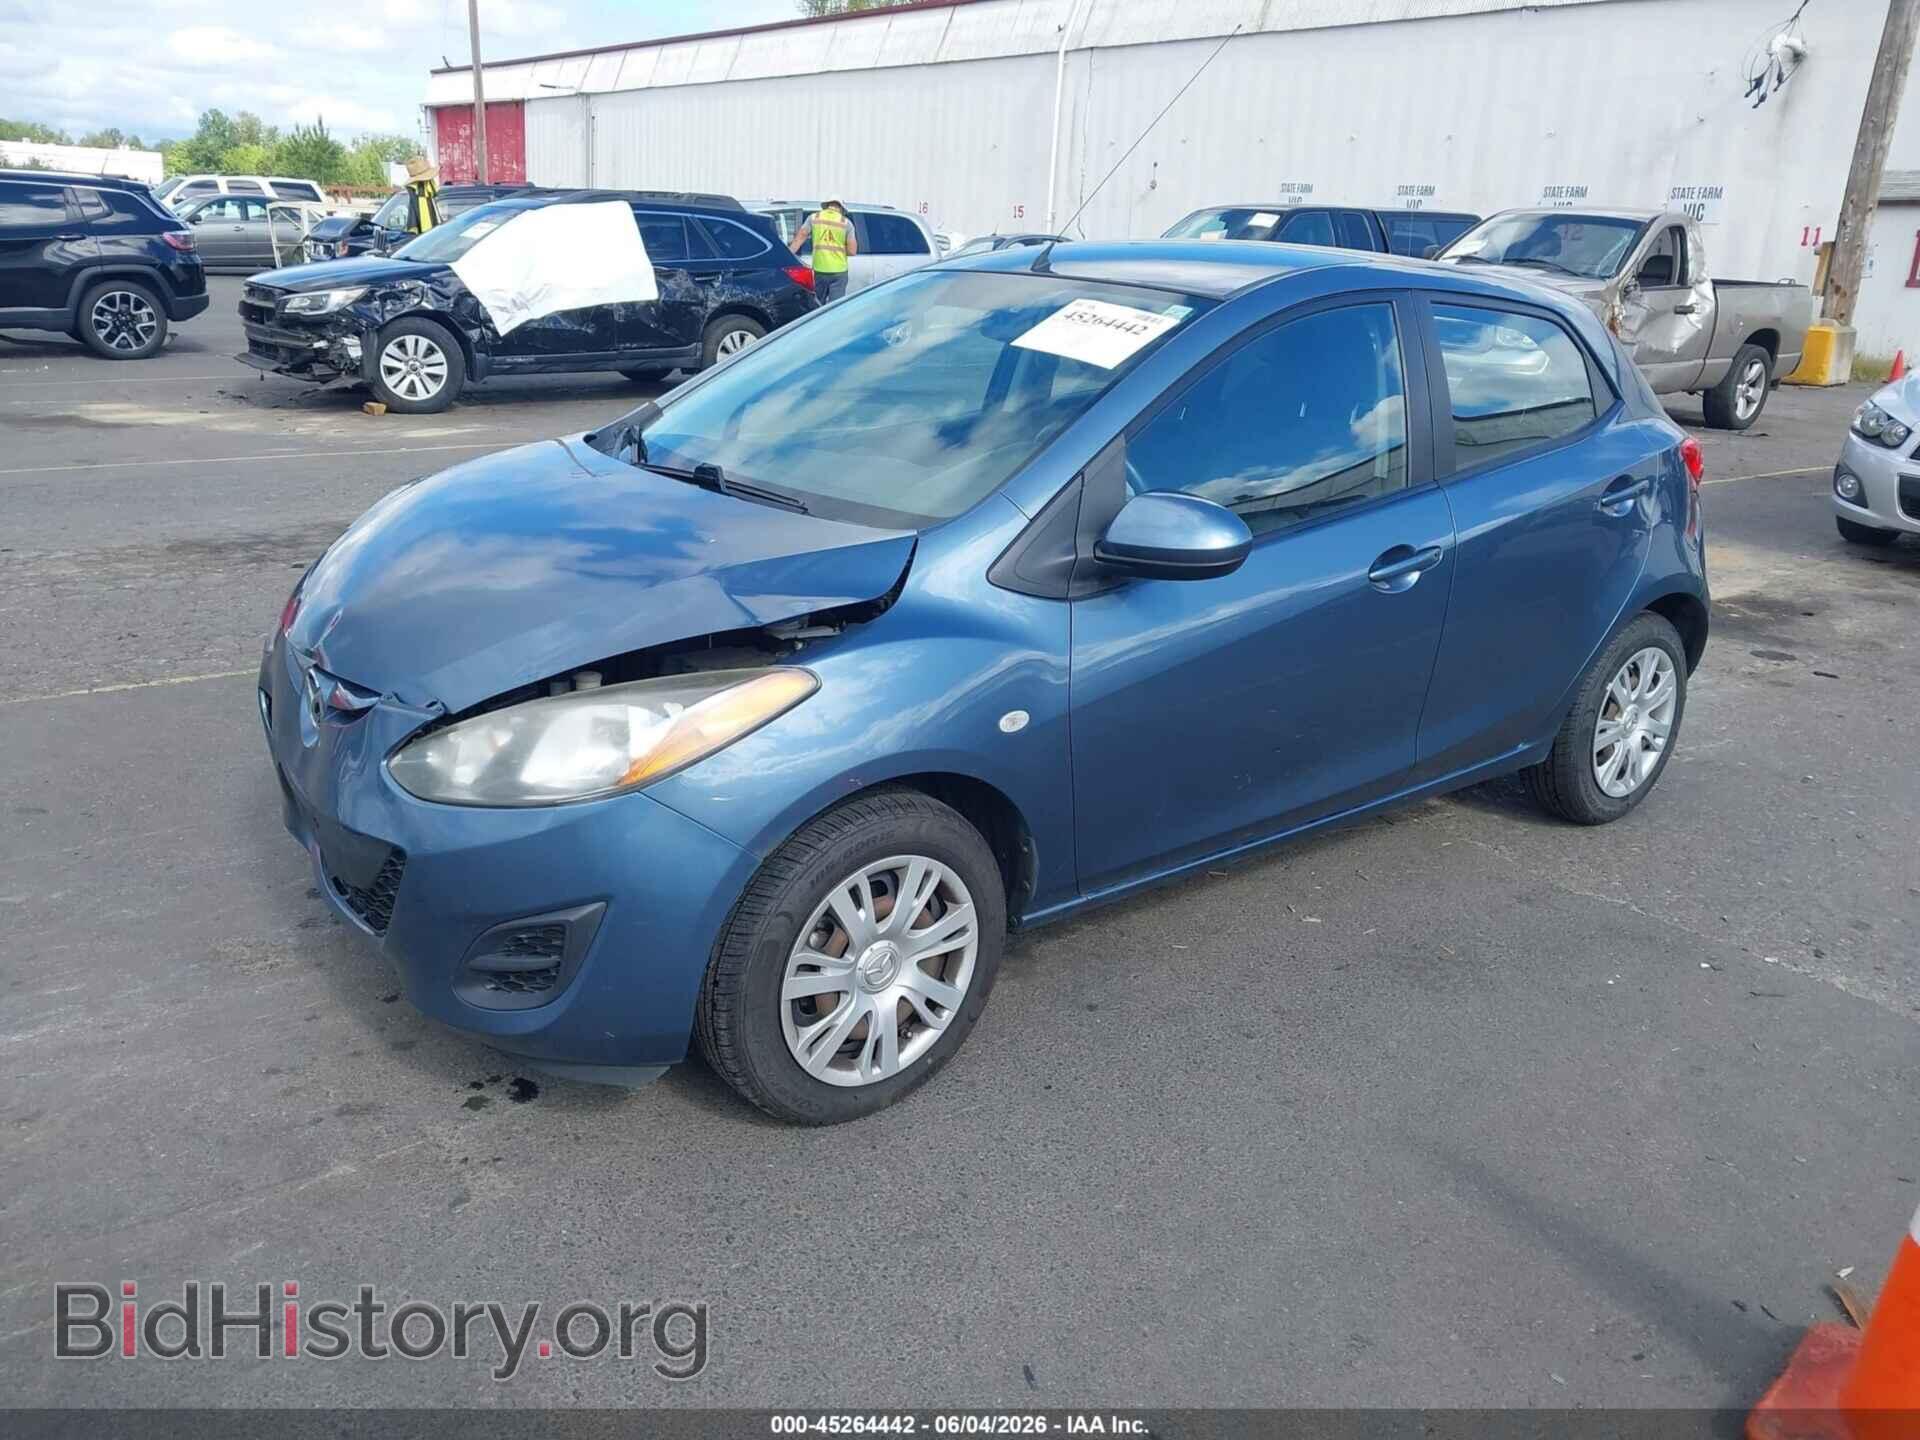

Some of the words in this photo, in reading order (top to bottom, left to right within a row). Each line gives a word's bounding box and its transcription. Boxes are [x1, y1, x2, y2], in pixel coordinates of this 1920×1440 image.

[1280, 183, 1297, 194] STATE
[1297, 184, 1314, 194] FARM
[1397, 185, 1415, 196] STATE
[1416, 185, 1435, 196] FARM
[1543, 186, 1564, 199] STATE
[1565, 186, 1588, 199] FARM
[1671, 187, 1696, 200] STATE
[1697, 187, 1723, 200] FARM
[1013, 205, 1025, 219] 15
[1683, 203, 1705, 222] VIC
[1801, 226, 1821, 246] 11
[1064, 311, 1149, 335] 45264442
